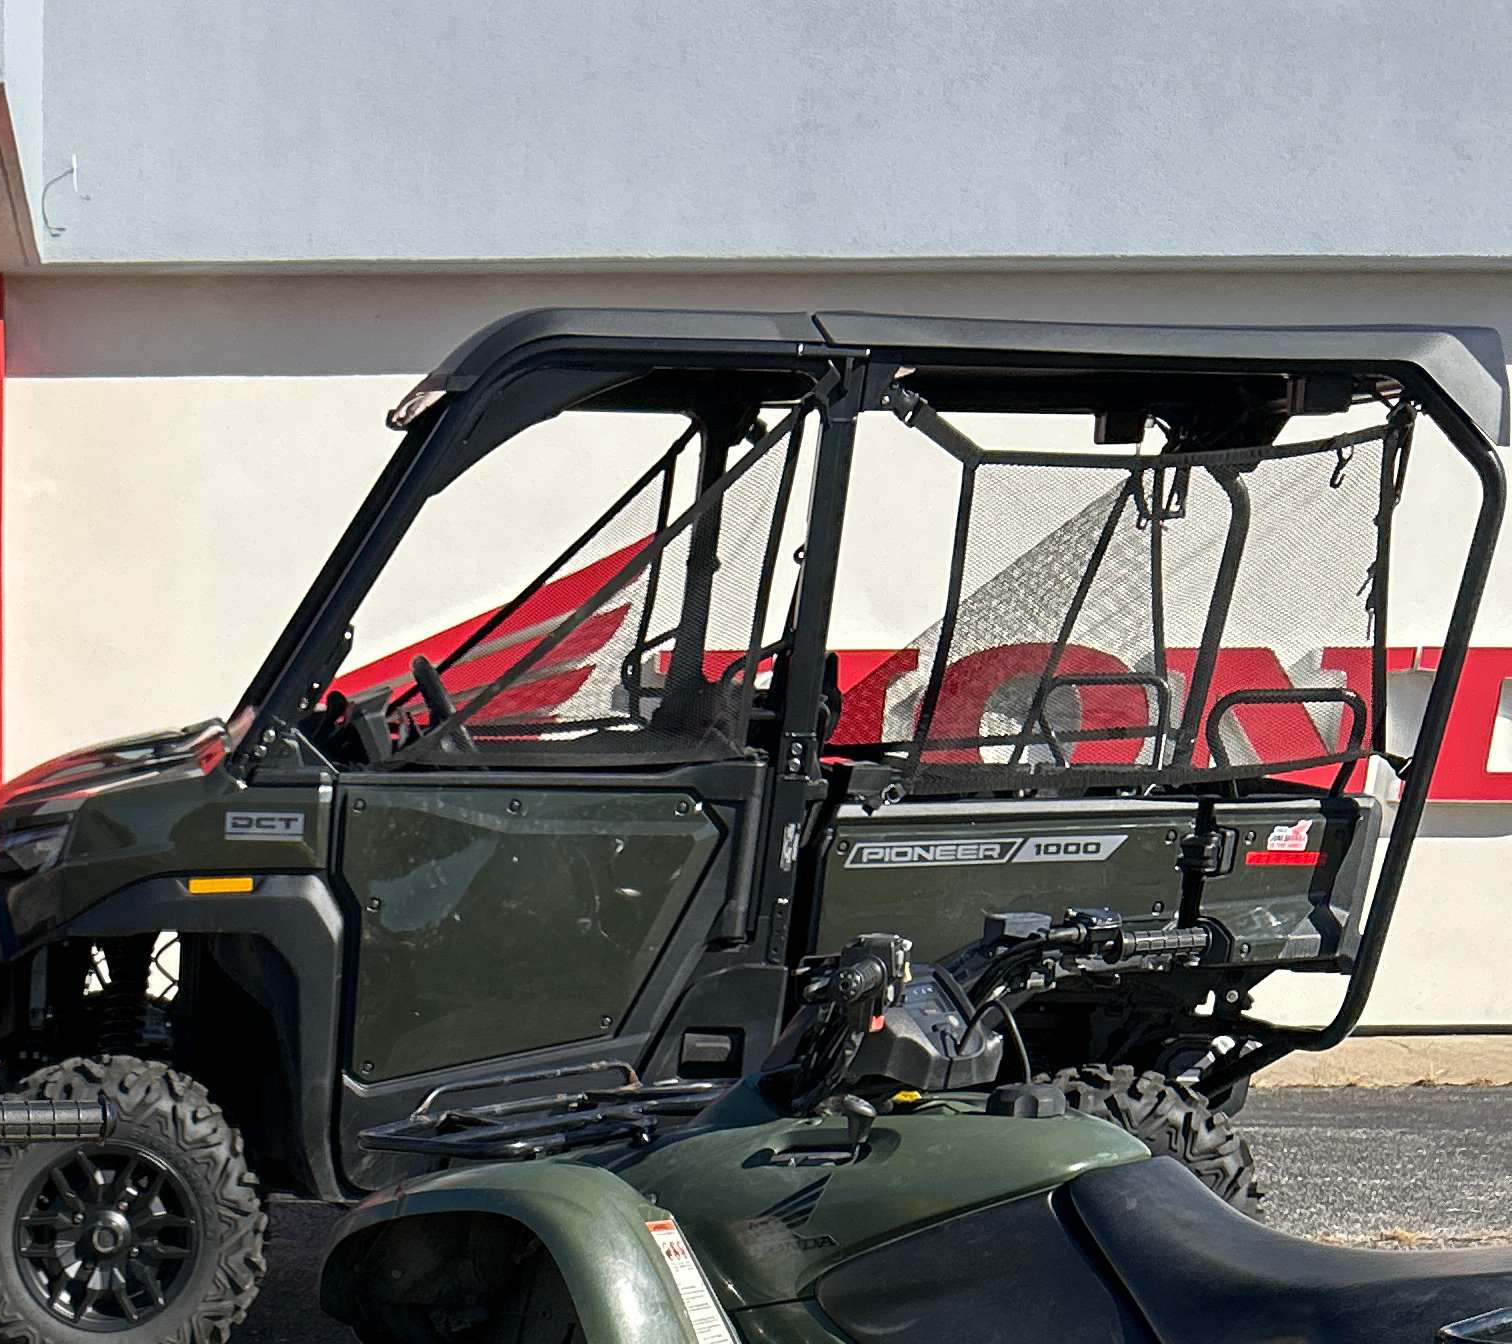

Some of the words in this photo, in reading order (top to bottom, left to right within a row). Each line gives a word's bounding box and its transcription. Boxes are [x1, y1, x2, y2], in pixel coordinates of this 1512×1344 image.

[231, 815, 299, 830] DCT
[861, 842, 1005, 862] PIONEER
[1034, 841, 1102, 857] 1000
